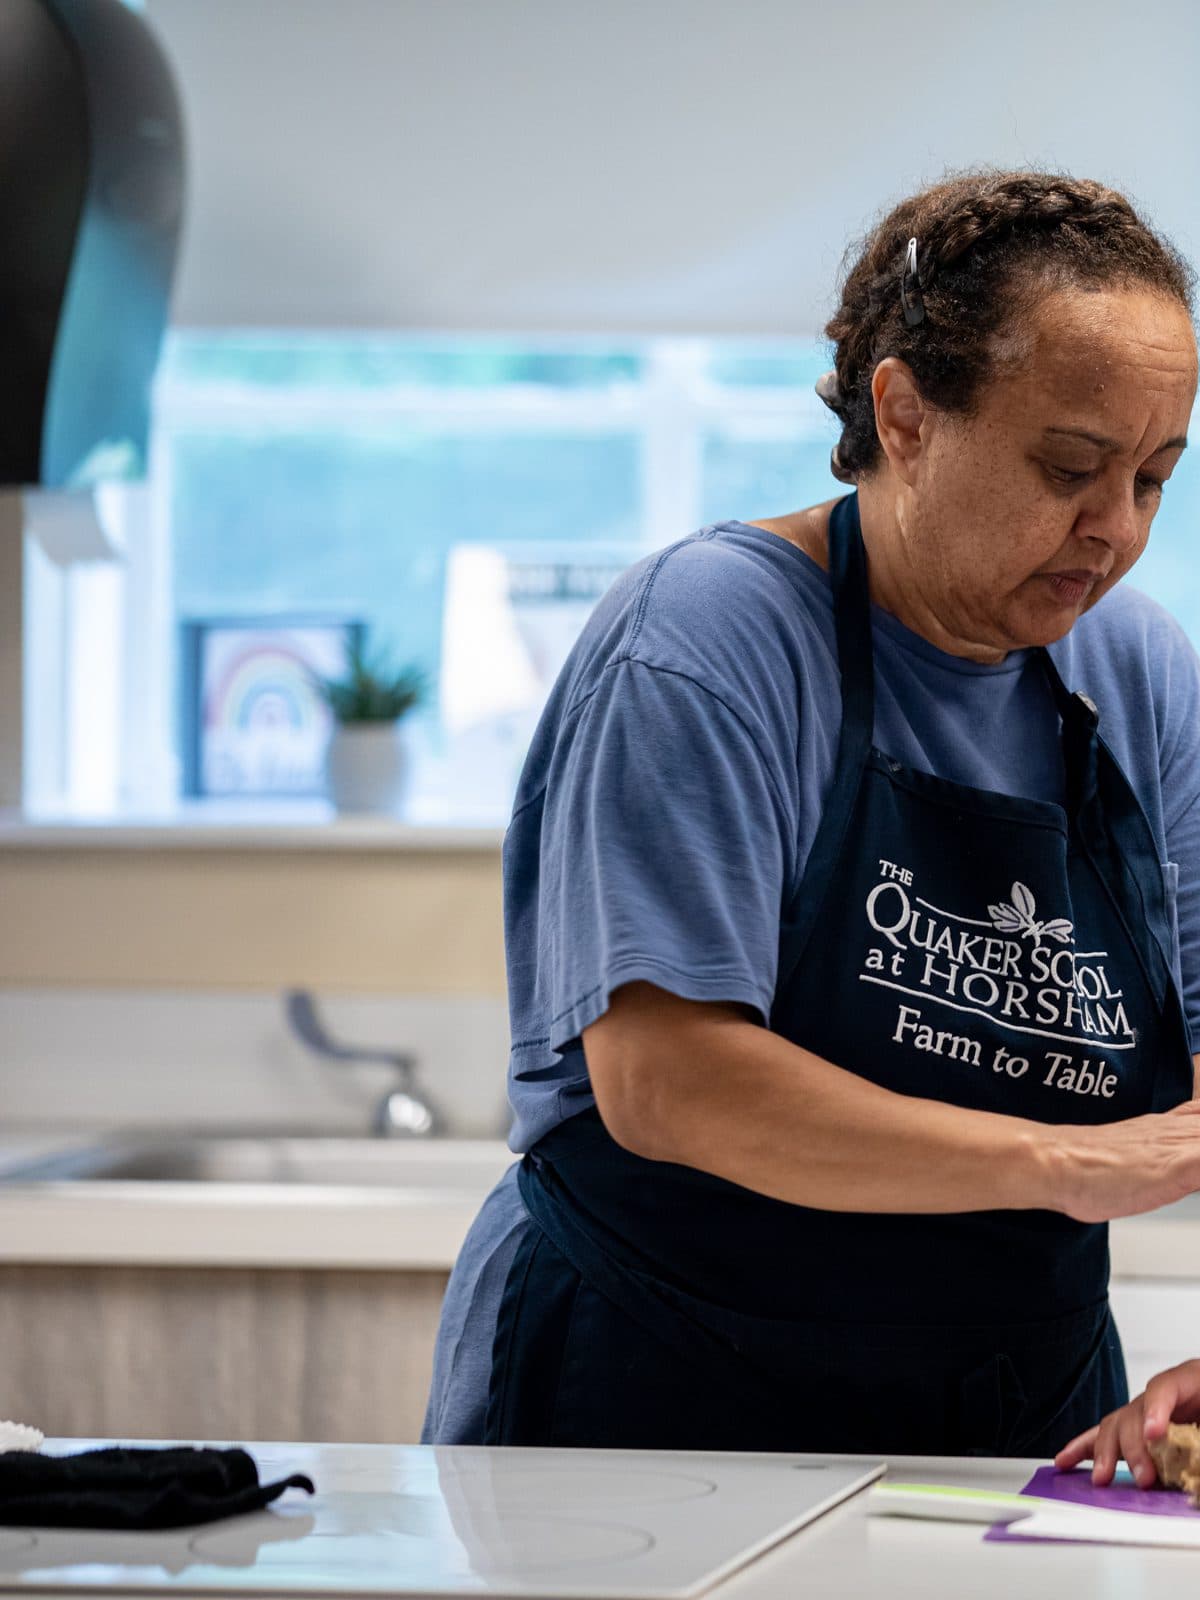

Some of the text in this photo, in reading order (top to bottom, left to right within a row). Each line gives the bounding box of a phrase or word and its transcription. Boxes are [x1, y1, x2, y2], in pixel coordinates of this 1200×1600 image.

[879, 859, 914, 886] THE
[865, 882, 1123, 999] QUAKER SCOL
[864, 948, 1134, 1036] at HORSHAM
[892, 1004, 1119, 1098] Farm to Table
